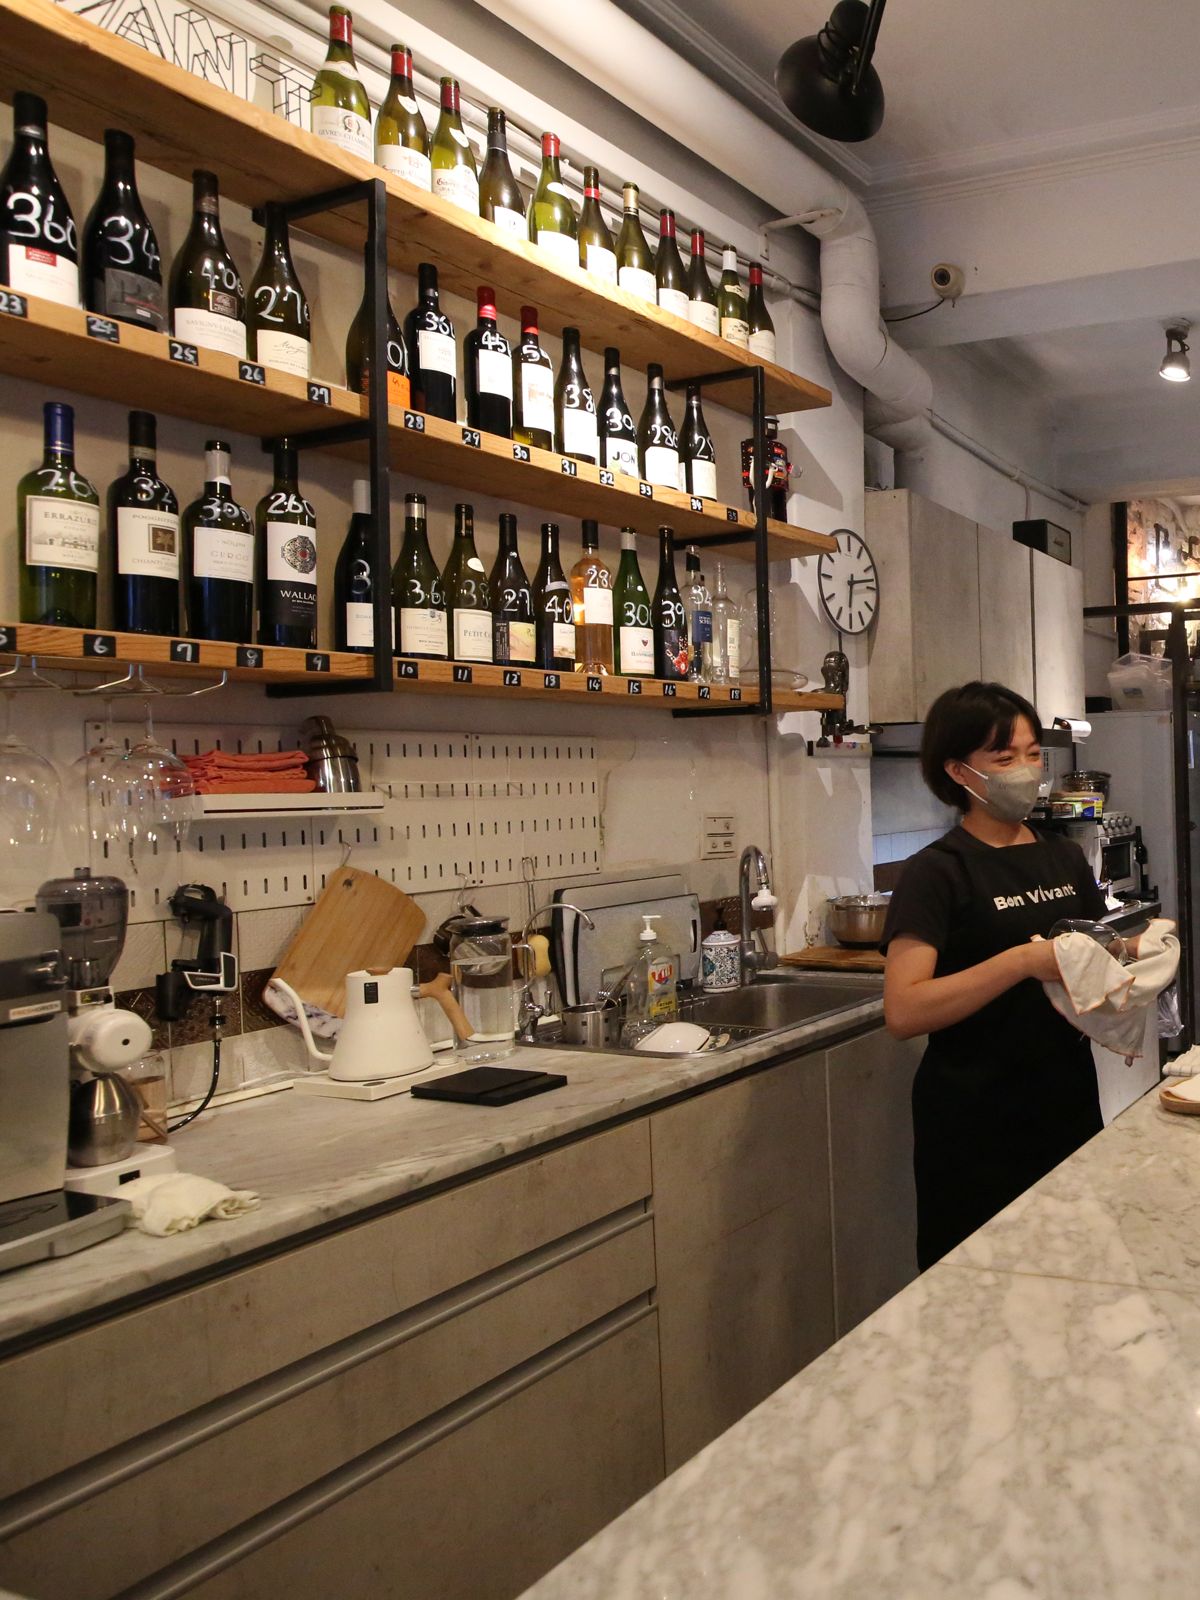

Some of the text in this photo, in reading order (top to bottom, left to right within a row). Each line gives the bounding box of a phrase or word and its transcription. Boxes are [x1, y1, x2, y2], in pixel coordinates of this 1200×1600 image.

[90, 318, 116, 334] 24
[171, 344, 196, 362] 25
[242, 366, 263, 381] 26
[310, 387, 329, 404] 27
[406, 414, 424, 430] 28
[464, 431, 480, 445] 29
[513, 446, 527, 459] 30
[562, 460, 575, 474] 31
[600, 472, 614, 484] 32
[640, 483, 651, 495] 33
[691, 499, 702, 510] 34
[727, 509, 737, 520] 35
[93, 637, 109, 654] 6
[177, 643, 192, 661] 7
[314, 656, 323, 670] 9
[401, 664, 414, 674] 10
[457, 669, 468, 681] 11
[505, 673, 518, 685] 12
[545, 676, 556, 687] 13
[589, 680, 600, 690] 14
[630, 682, 639, 693] 15
[665, 684, 674, 695] 16
[731, 689, 740, 699] 18
[993, 883, 1077, 911] Bon Vivant
